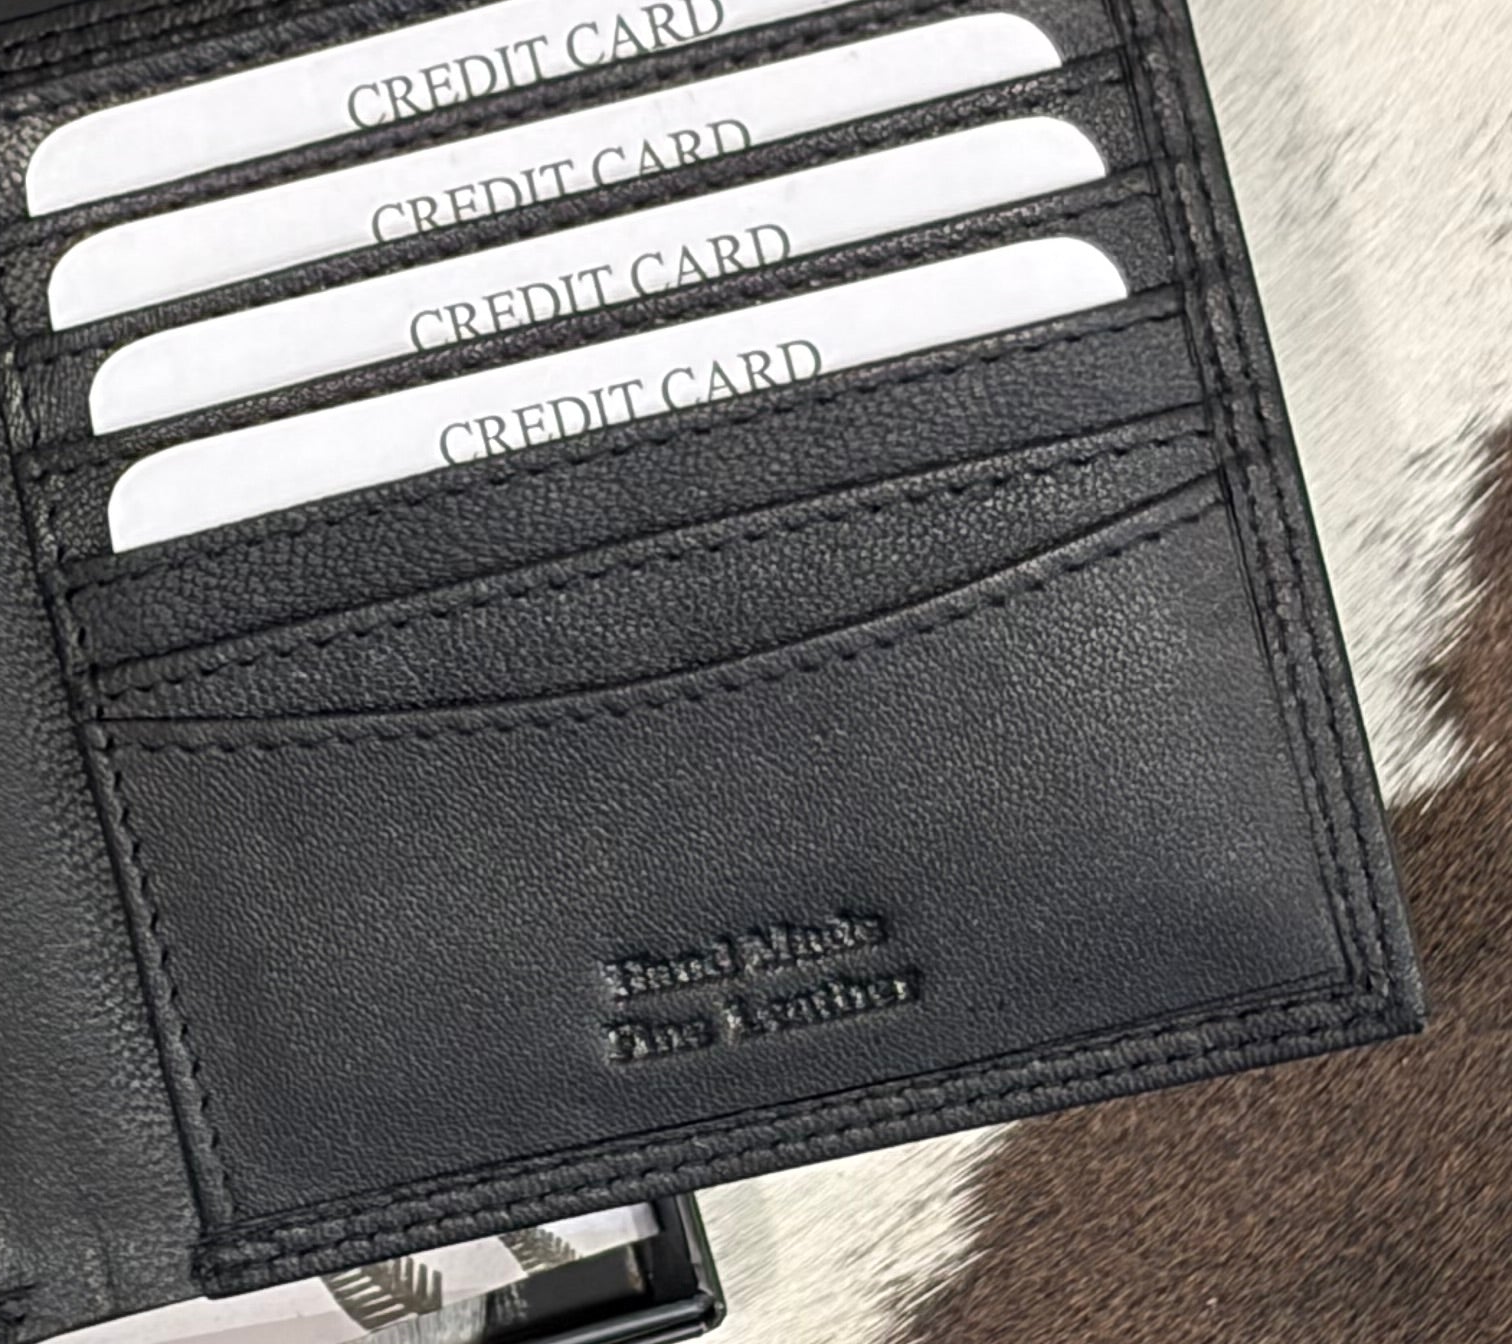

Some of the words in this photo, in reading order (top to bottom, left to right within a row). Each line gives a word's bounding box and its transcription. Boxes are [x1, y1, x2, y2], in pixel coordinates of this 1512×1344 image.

[348, 35, 548, 129] CREDIT
[371, 159, 575, 243] CREDIT
[592, 119, 751, 187] CARD
[409, 264, 613, 351] CREDIT
[630, 223, 790, 297] CARD
[439, 378, 644, 466] CREDIT
[661, 339, 822, 412] CARD
